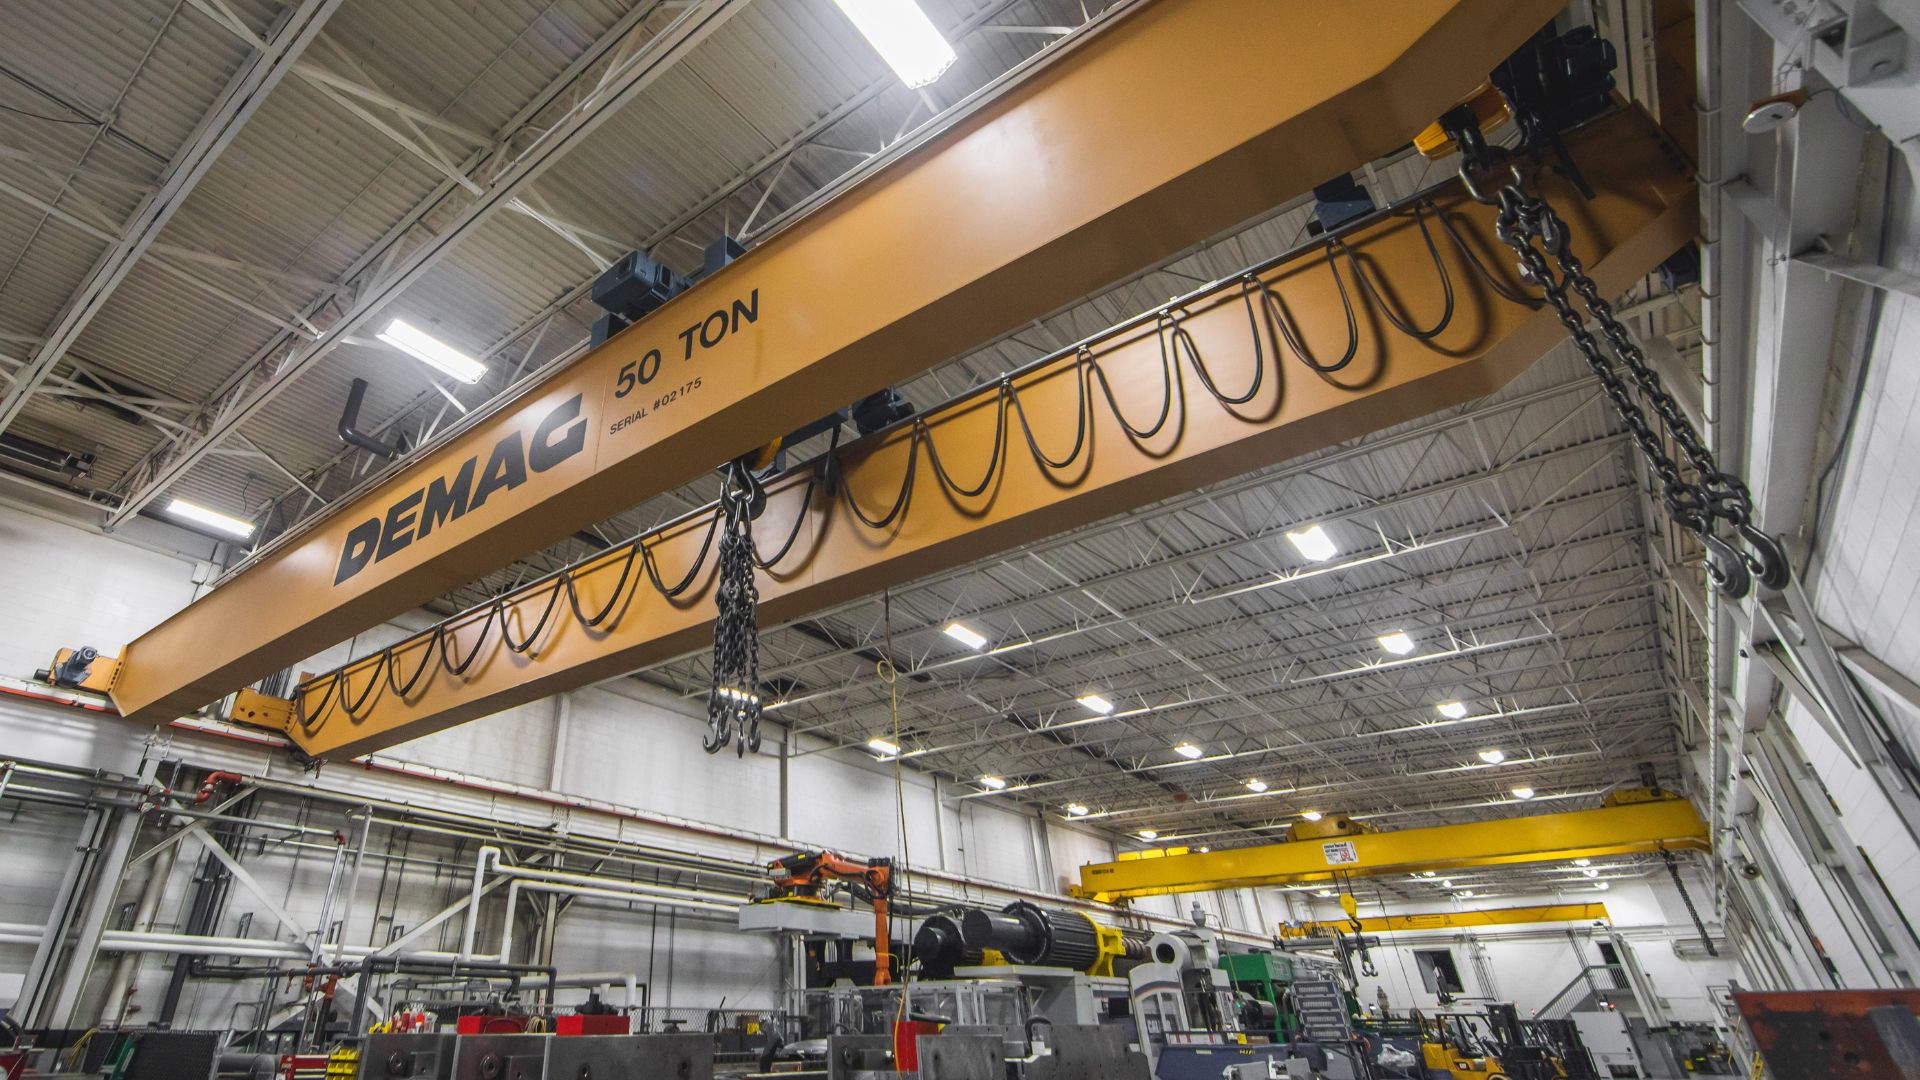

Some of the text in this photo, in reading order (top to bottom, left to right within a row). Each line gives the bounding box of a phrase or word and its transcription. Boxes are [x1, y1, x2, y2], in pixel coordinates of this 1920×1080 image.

[614, 288, 759, 399] 50 TON
[610, 377, 702, 435] SERIAL #02175
[333, 392, 588, 587] DEMAG
